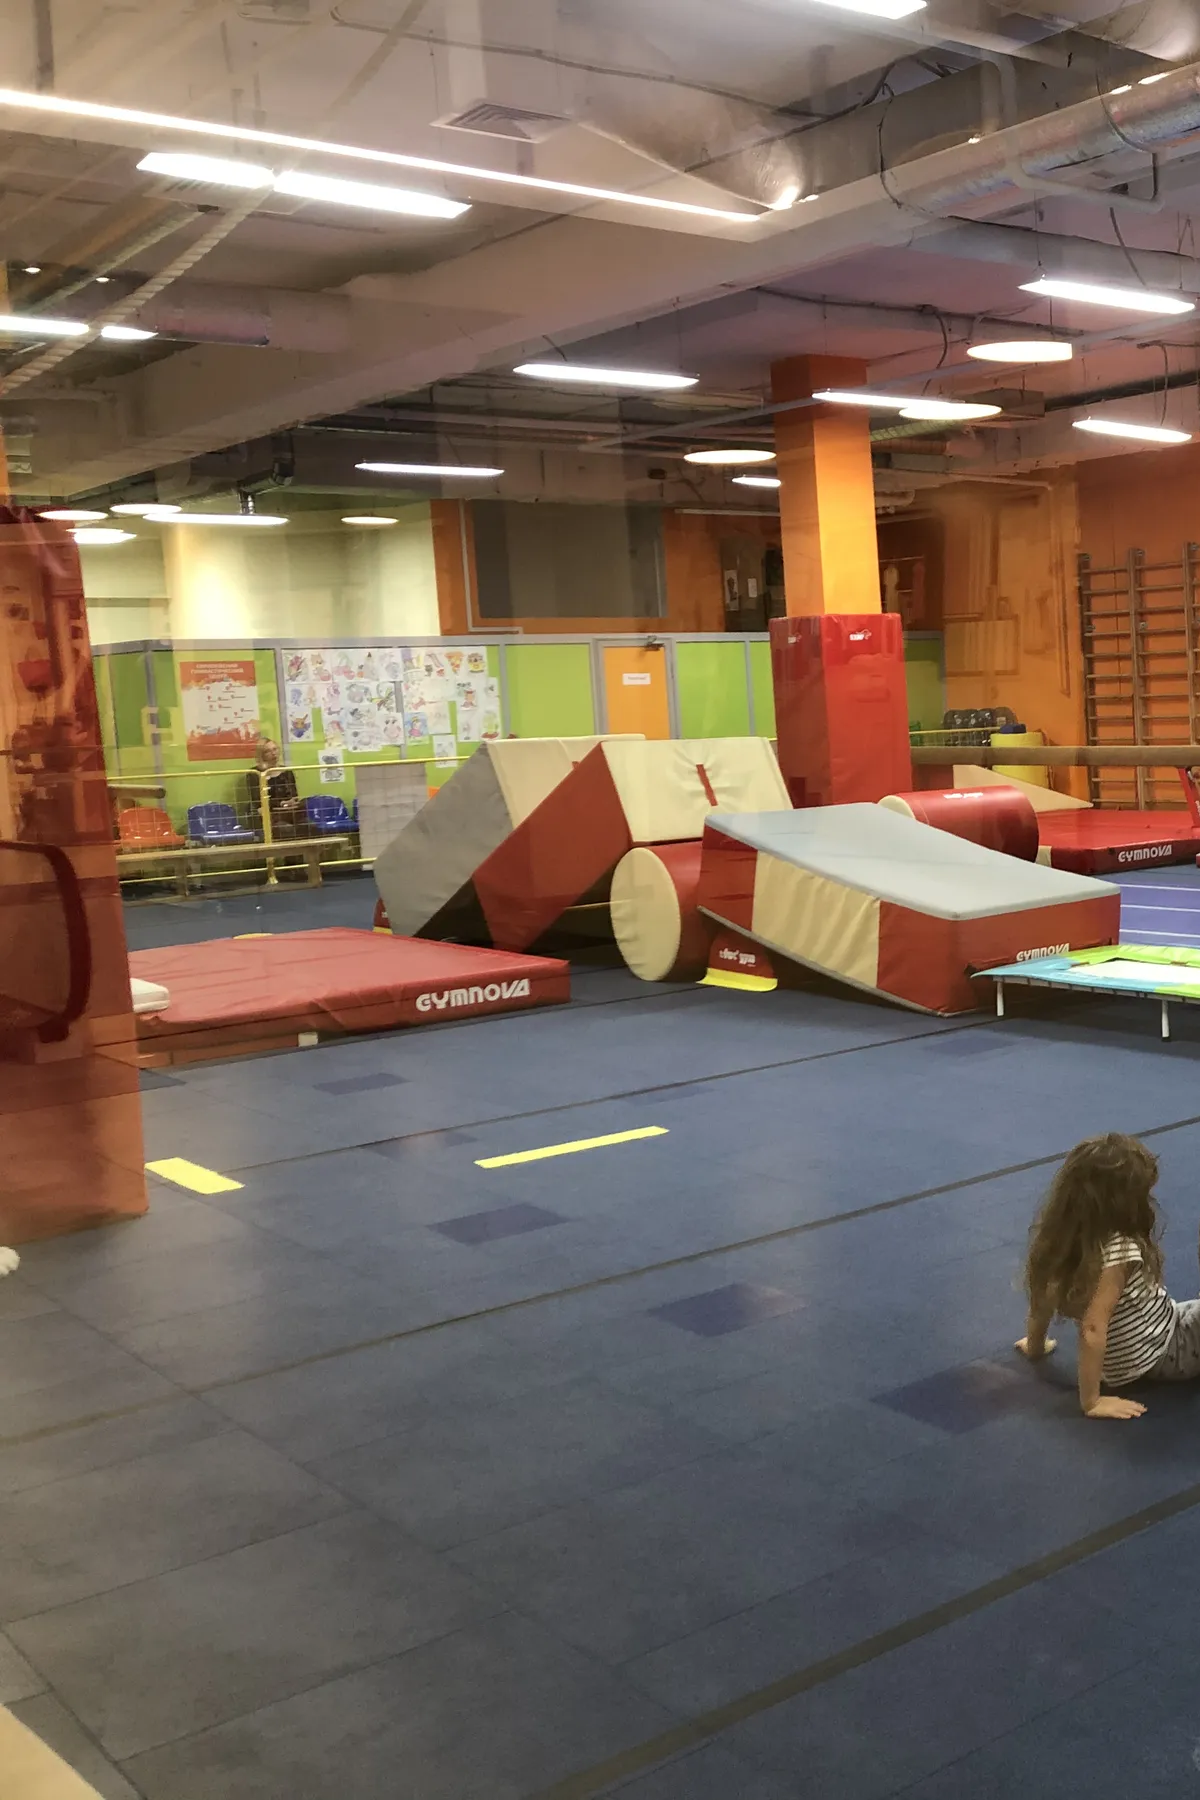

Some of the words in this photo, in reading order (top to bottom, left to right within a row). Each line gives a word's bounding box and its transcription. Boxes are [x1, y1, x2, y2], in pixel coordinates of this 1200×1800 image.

[1118, 844, 1172, 863] GYMNOVA
[1016, 942, 1070, 962] GYMNOVA
[415, 978, 531, 1012] GYMNOVA
